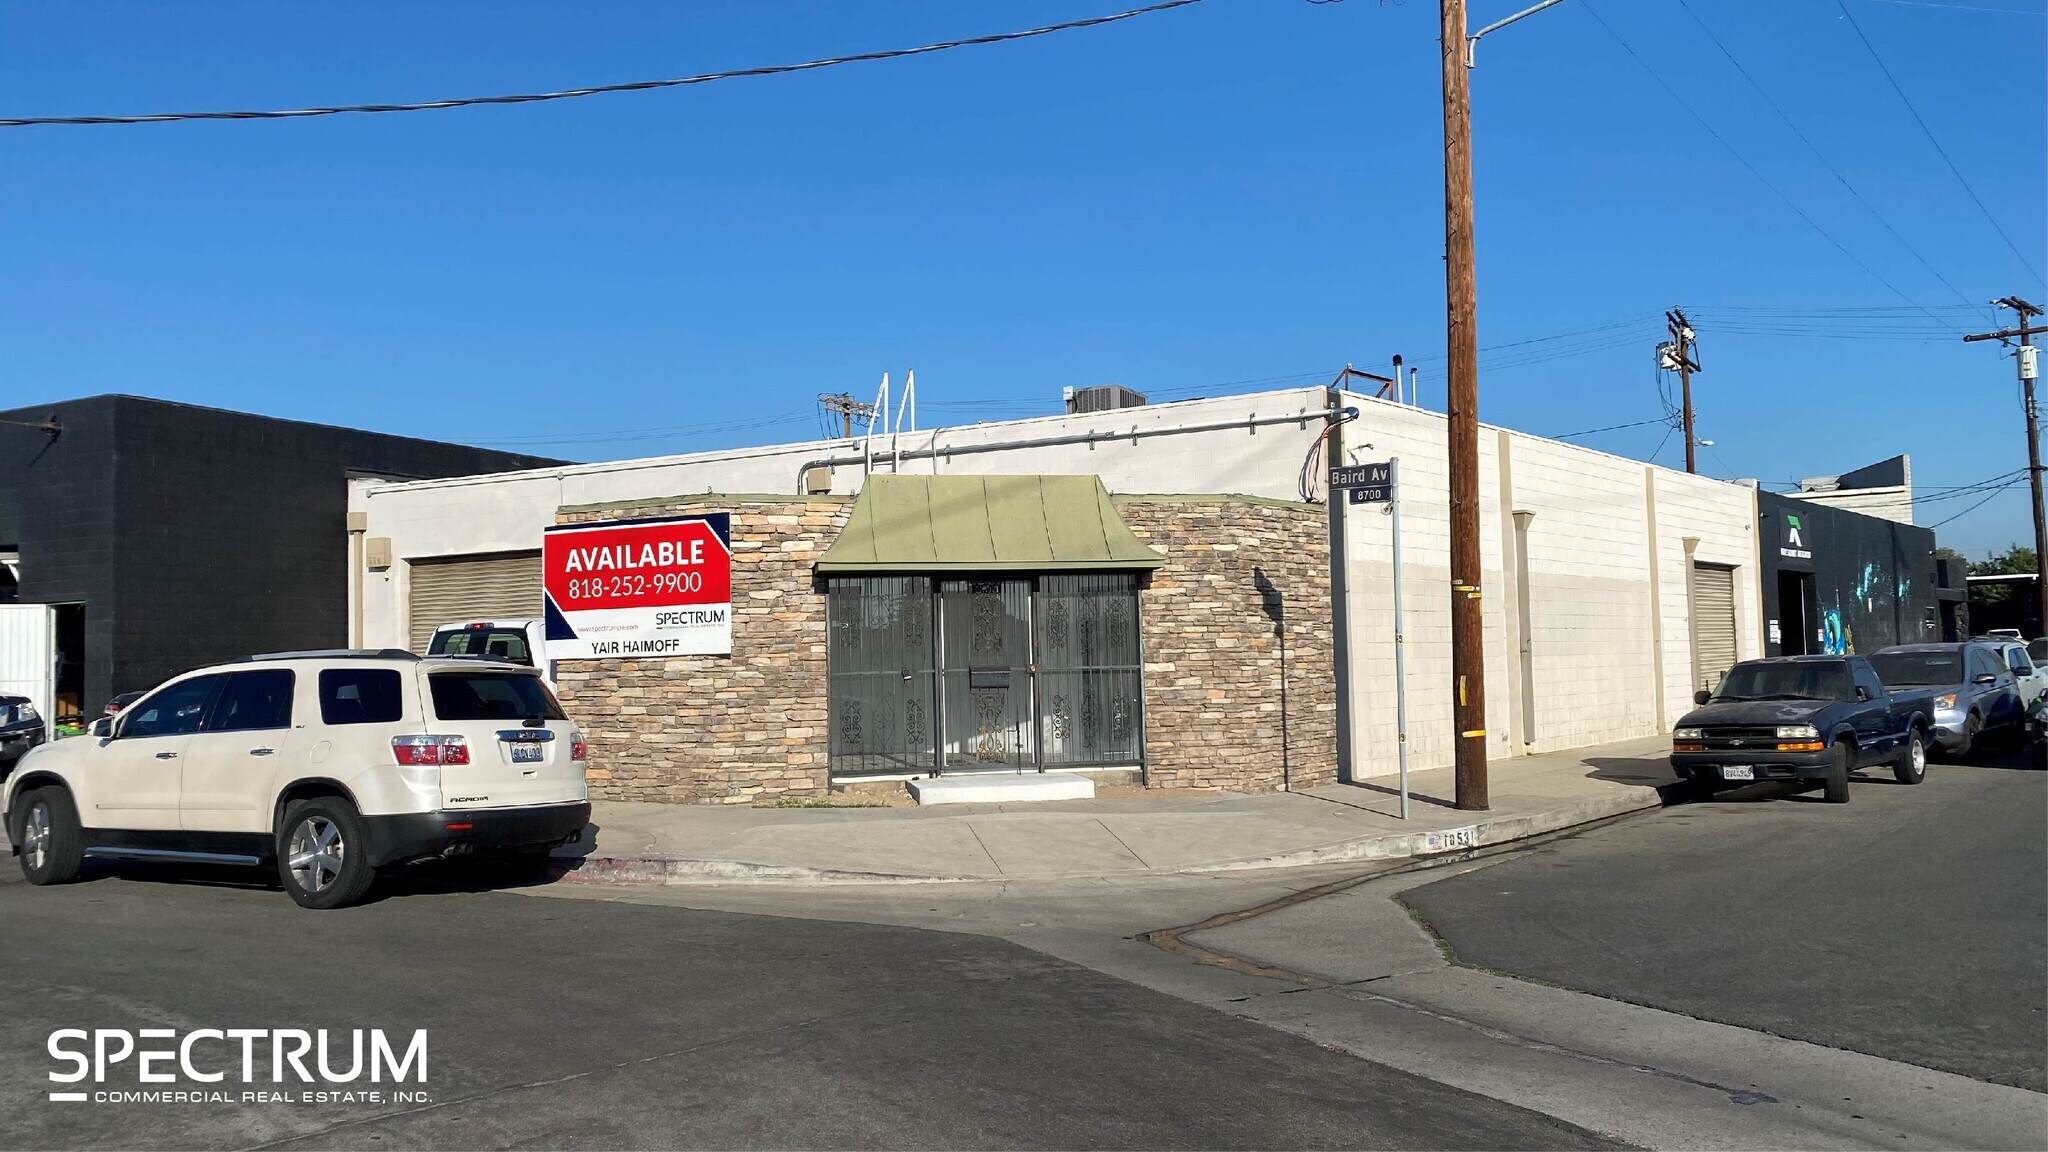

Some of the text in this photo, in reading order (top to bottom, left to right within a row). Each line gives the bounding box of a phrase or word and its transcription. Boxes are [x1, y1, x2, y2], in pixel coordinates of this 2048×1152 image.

[1332, 467, 1388, 485] Baird Av
[1357, 489, 1381, 500] 8700
[565, 539, 704, 573] AVAILABLE
[568, 571, 702, 599] 818-252-9900
[656, 609, 725, 625] SPECTRUM
[591, 639, 680, 655] YAIR HAIMOFF
